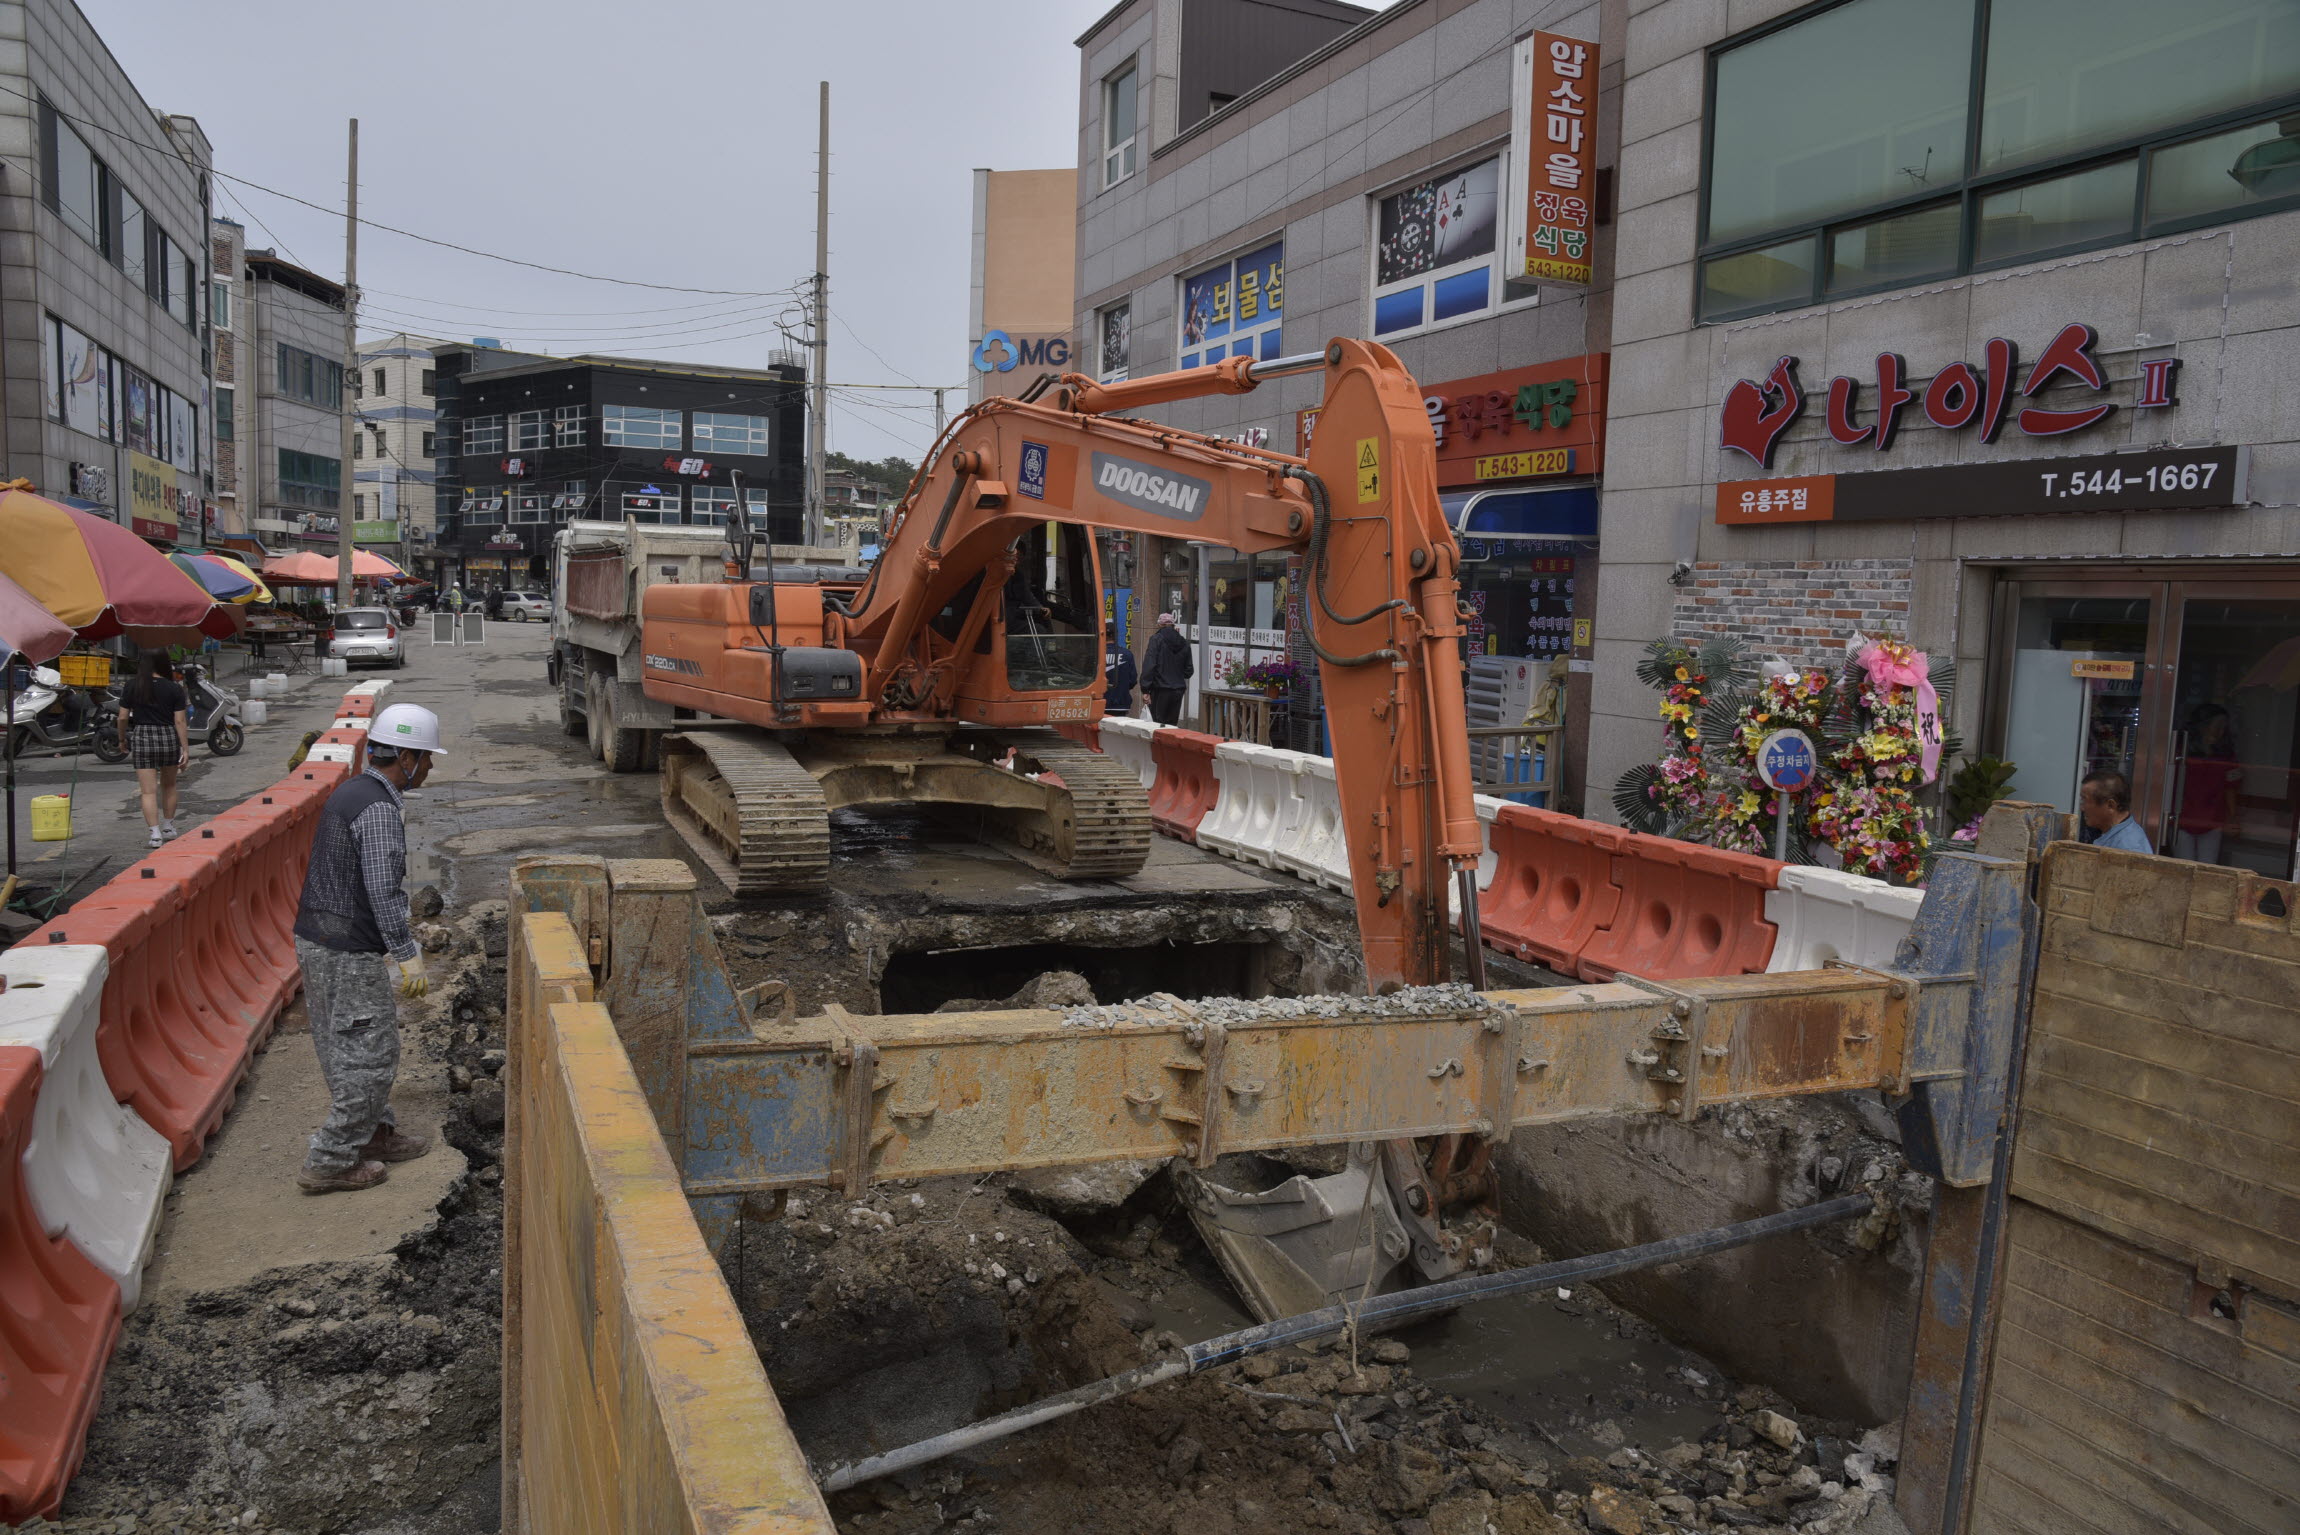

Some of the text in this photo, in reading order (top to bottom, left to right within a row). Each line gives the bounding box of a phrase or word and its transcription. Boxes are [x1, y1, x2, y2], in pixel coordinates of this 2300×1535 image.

[1545, 41, 1588, 190] 암소마을
[1534, 191, 1588, 227] 정육
[1533, 225, 1587, 259] 식당
[1528, 260, 1590, 283] 543-1220
[1020, 337, 1068, 366] MG
[1826, 322, 2112, 452] 나이스
[1456, 390, 1513, 440] 정육
[1513, 379, 1577, 433] 식당
[1478, 451, 1566, 478] T.543-1220
[2041, 462, 2219, 499] T.544-1667
[1099, 462, 1200, 513] DOOSAN
[1739, 487, 1808, 513] 유흥주점
[1105, 654, 1127, 665] NIE
[1767, 754, 1810, 767] 주정차금지
